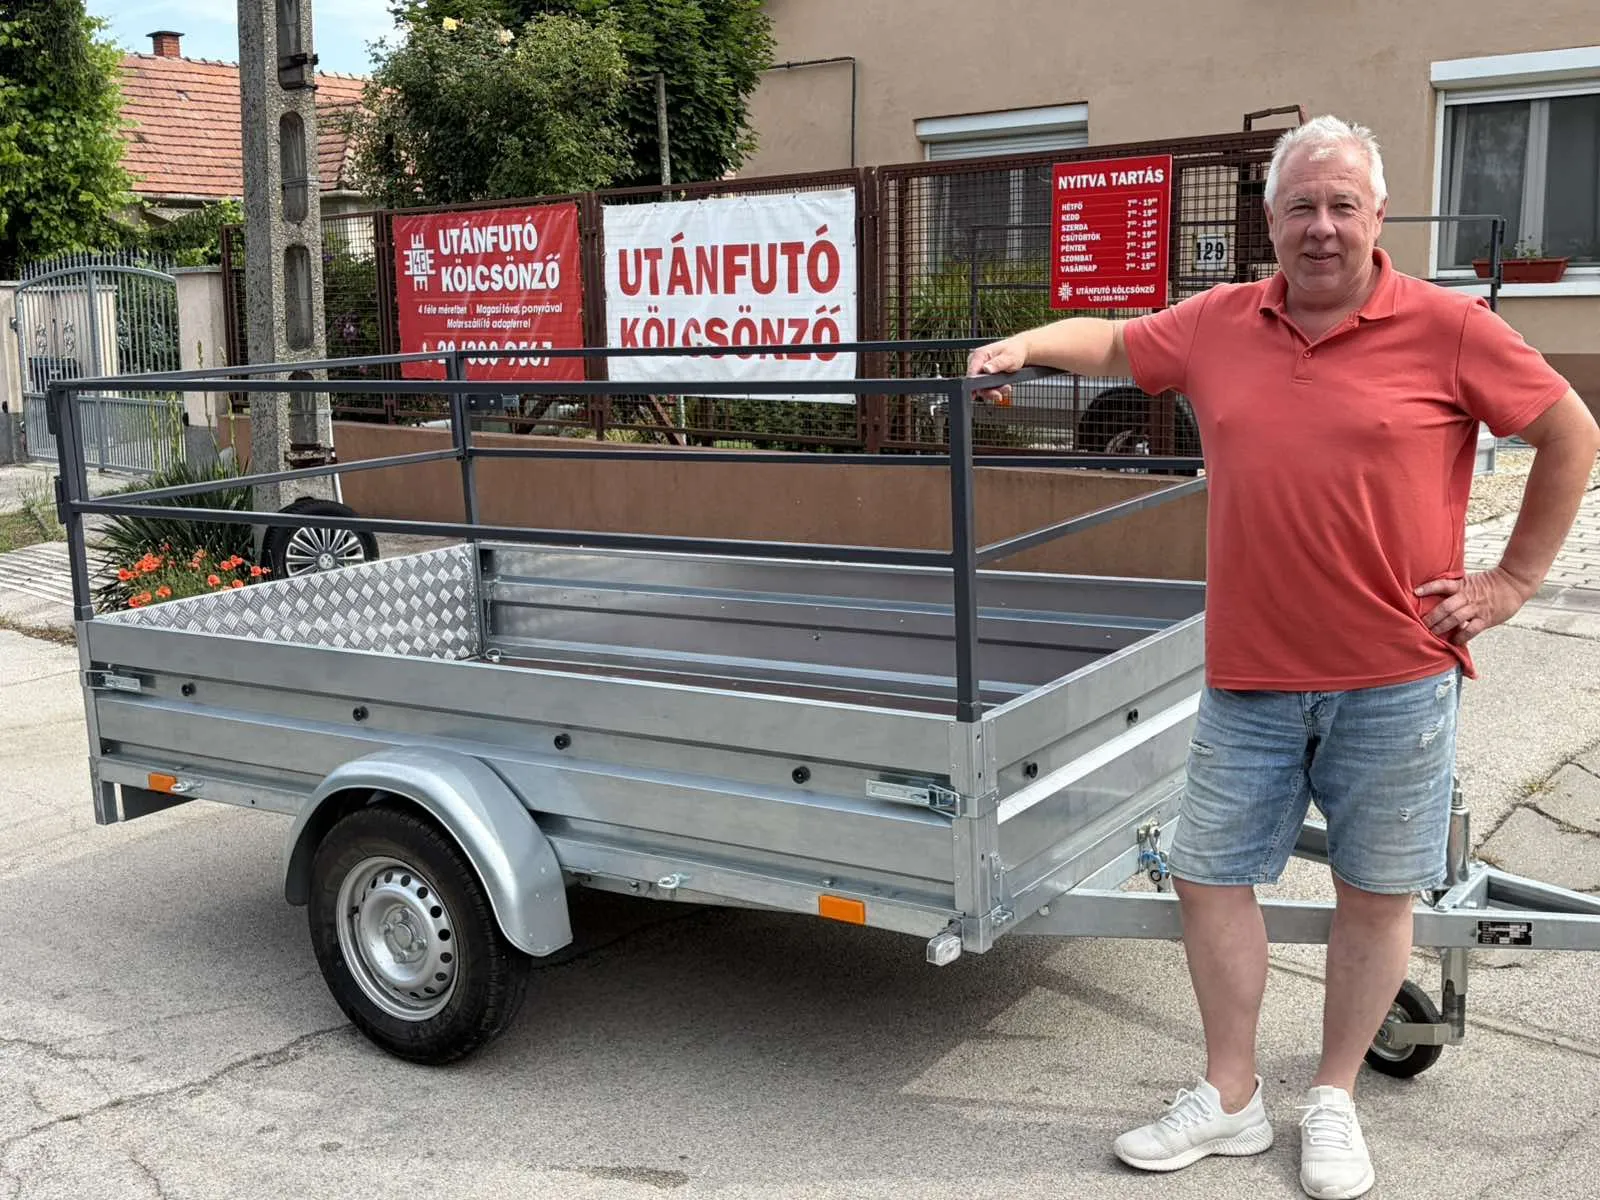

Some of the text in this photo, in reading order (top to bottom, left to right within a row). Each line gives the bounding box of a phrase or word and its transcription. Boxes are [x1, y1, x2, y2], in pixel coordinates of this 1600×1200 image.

[1058, 166, 1164, 189] NYITVA TARTÁS
[1061, 201, 1083, 211] HÉTFŐ
[1061, 213, 1080, 221] KEDD
[1061, 224, 1088, 232] SZERDA
[438, 216, 538, 255] UTÁNFUTÓ
[1060, 243, 1087, 252] PÉNTEK
[1196, 242, 1224, 260] 129
[618, 224, 840, 297] UTÁNFUTÓ
[1060, 254, 1093, 263] SZOMBAT
[1060, 263, 1097, 272] VASÁRNAP
[441, 253, 560, 292] KÖLCSÖNZŐ
[1076, 286, 1110, 295] UTÁNFUTÓ
[418, 304, 423, 313] 4
[620, 304, 841, 362] KÖLCSÖNZŐ
